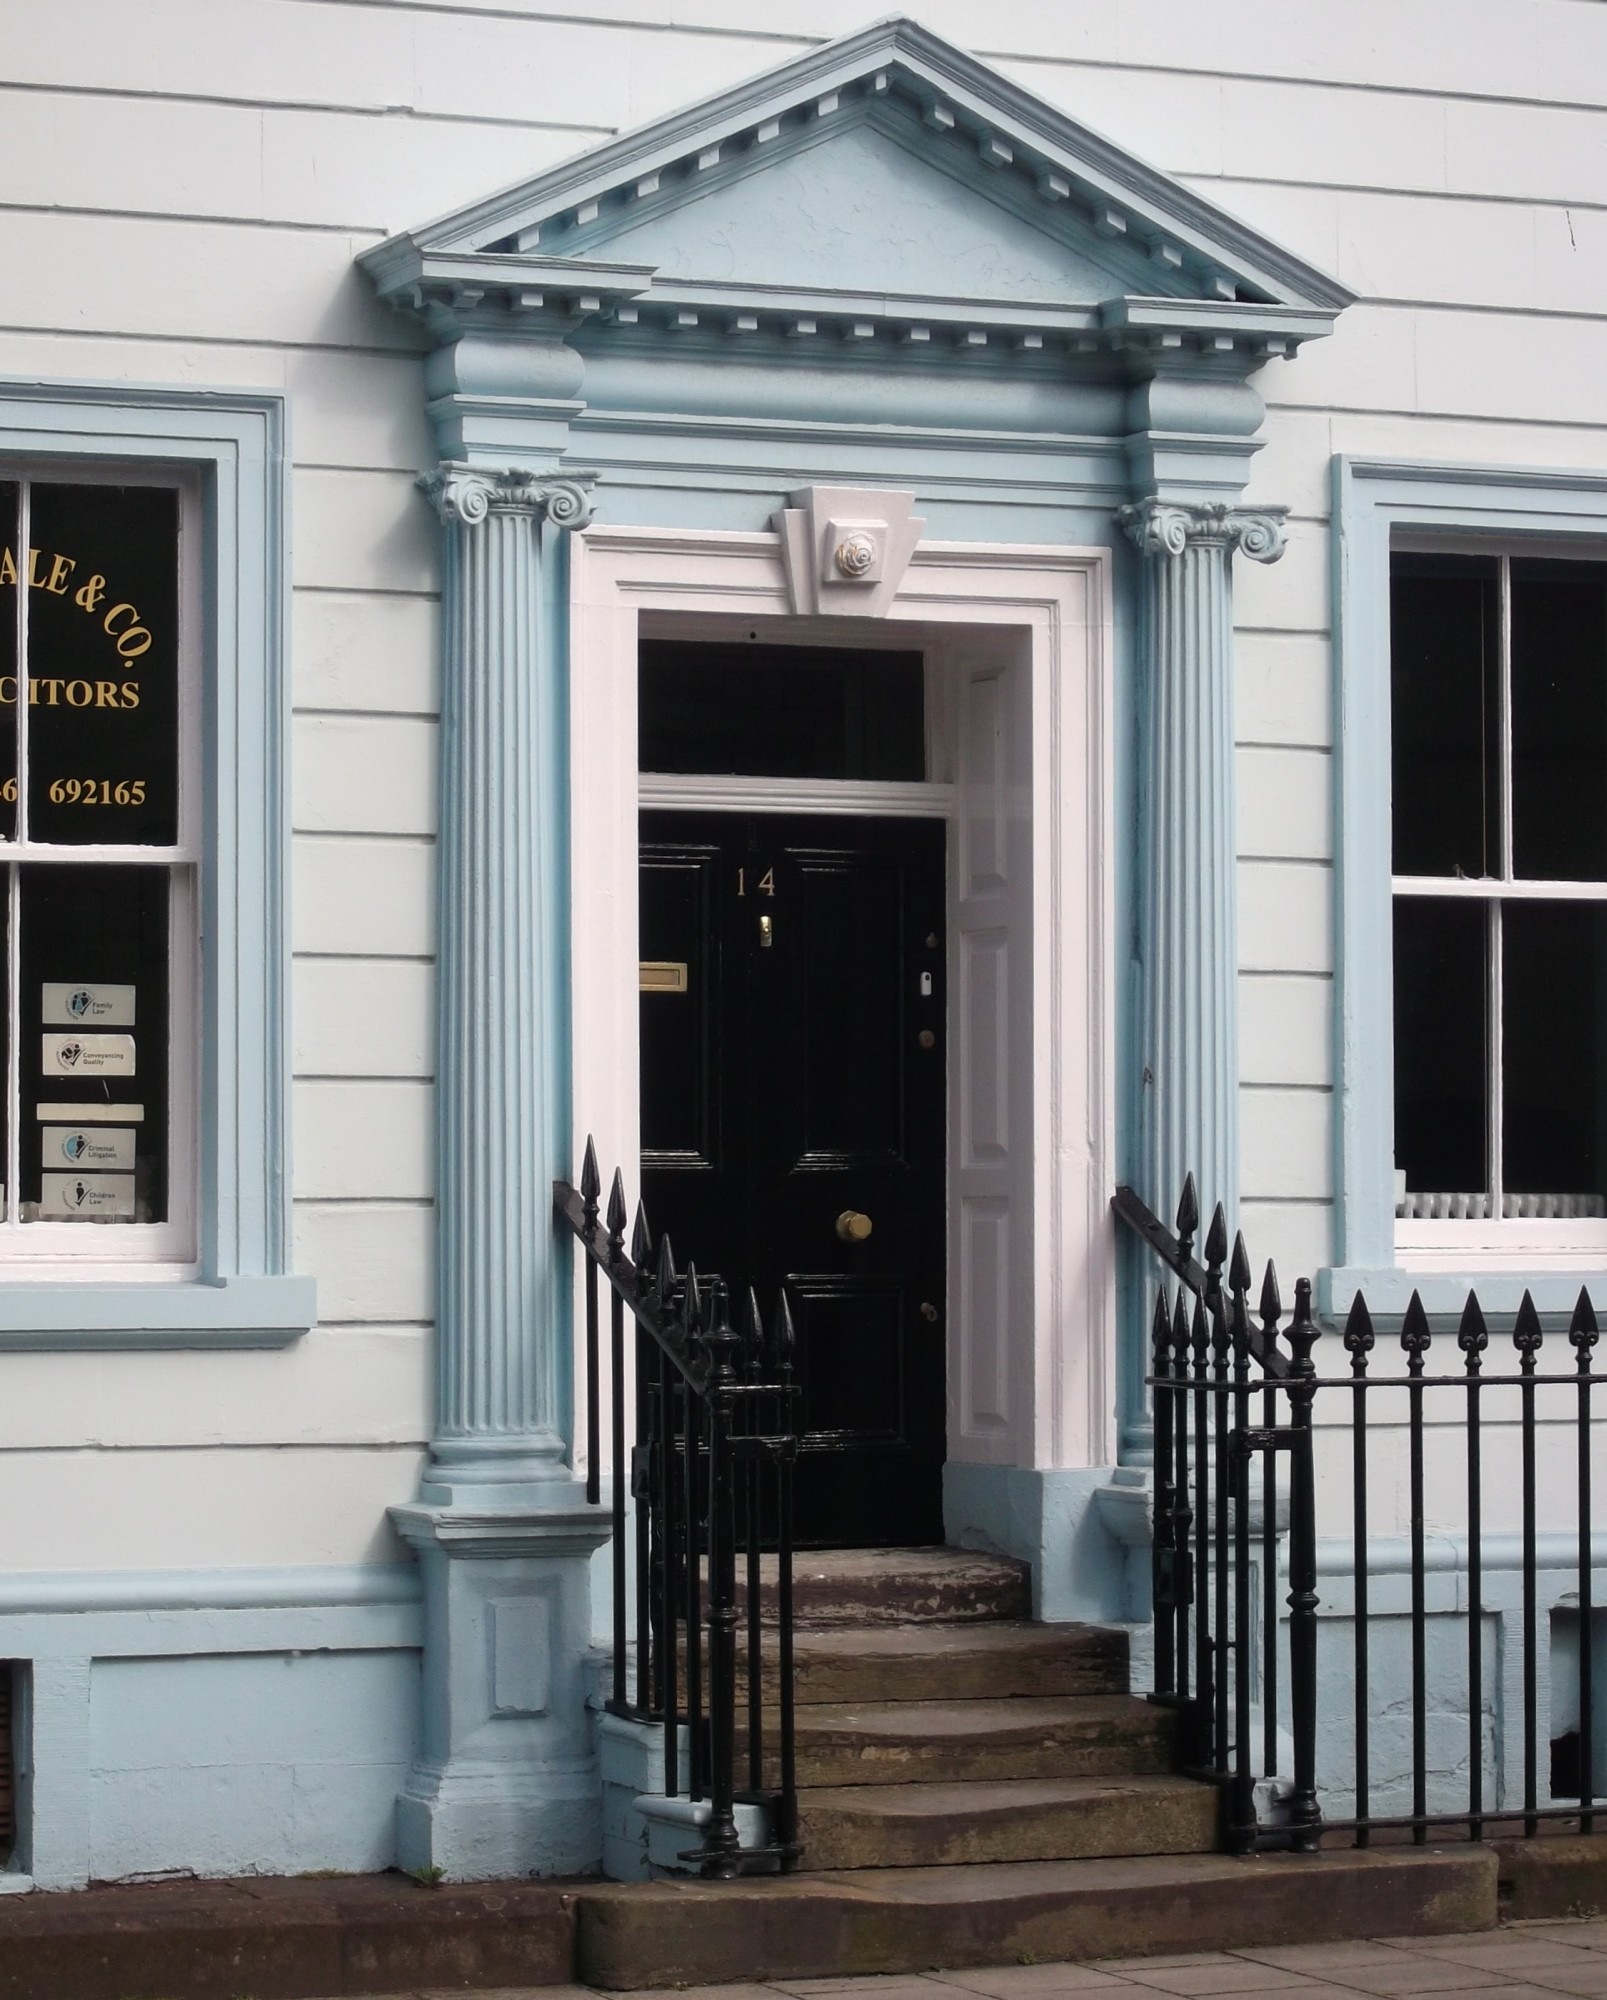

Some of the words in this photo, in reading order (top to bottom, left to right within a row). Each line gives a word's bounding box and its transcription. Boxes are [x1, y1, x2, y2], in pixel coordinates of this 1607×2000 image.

[0, 546, 76, 595] ALE
[75, 574, 106, 613] &
[103, 603, 153, 668] CO.
[0, 676, 140, 709] CITORS
[49, 778, 146, 806] 692165
[92, 1001, 113, 1009] Family
[83, 1052, 124, 1060] Conveyancing
